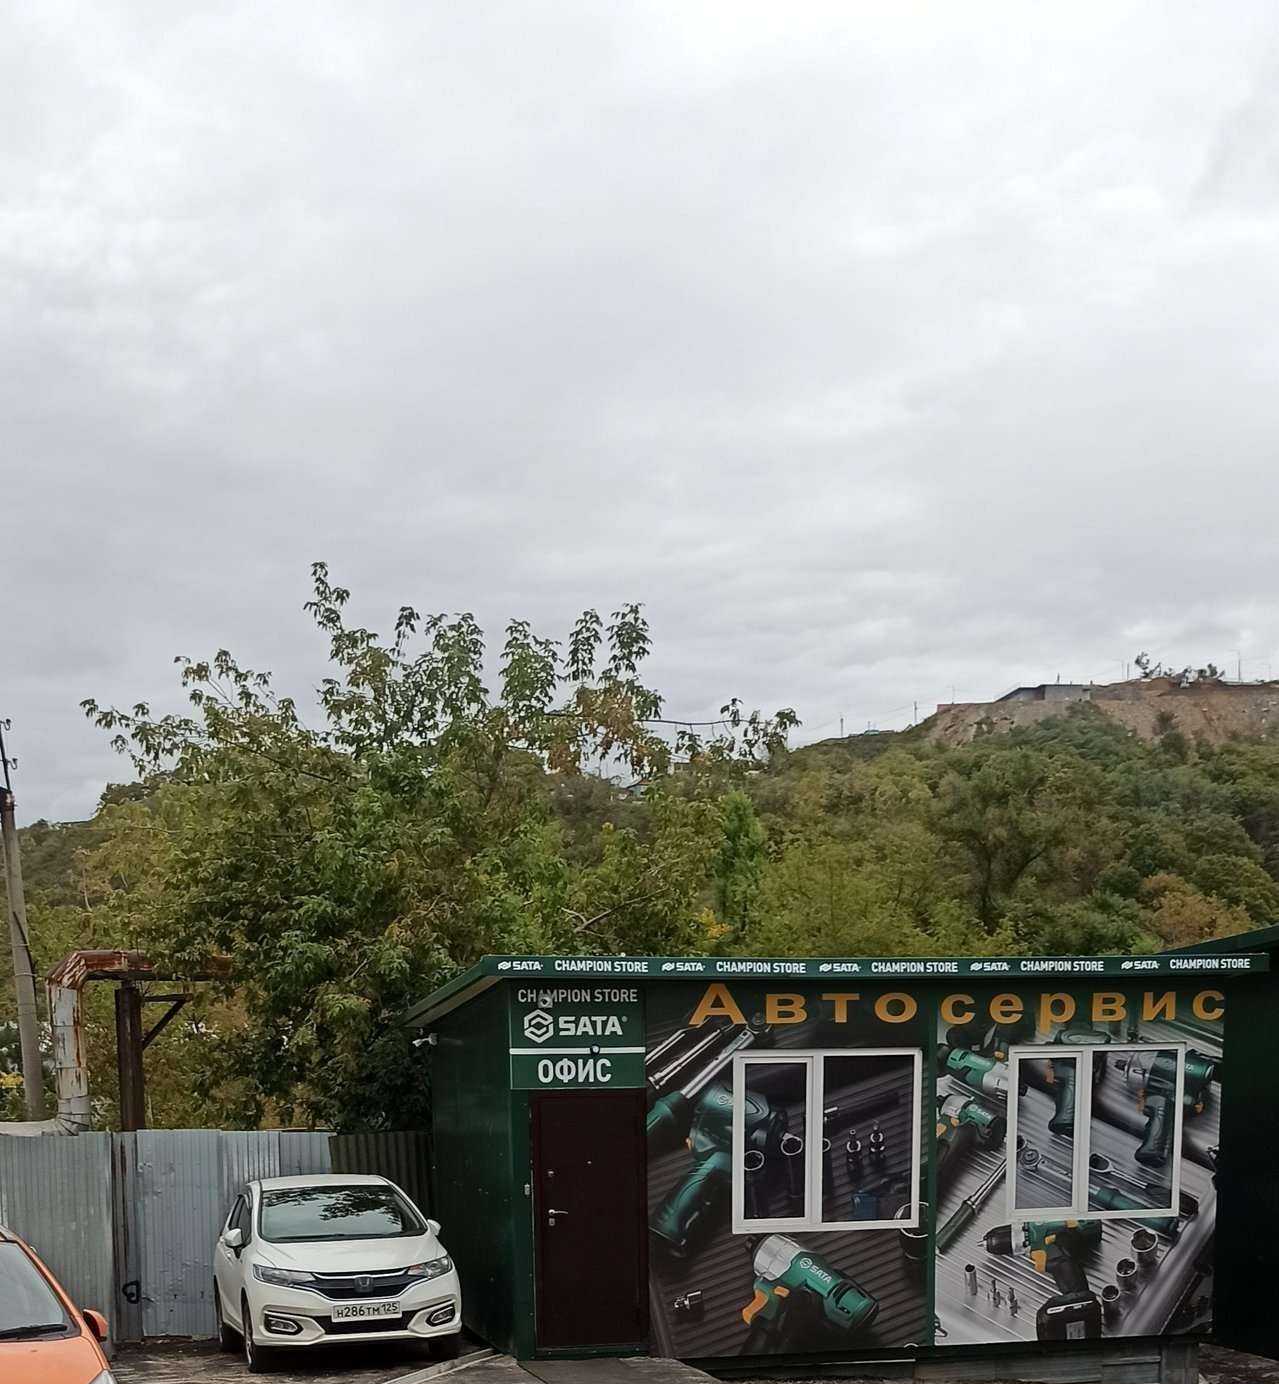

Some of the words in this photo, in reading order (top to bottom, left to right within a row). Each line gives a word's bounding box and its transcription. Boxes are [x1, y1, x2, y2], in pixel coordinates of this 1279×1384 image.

[512, 961, 543, 970] SATA
[554, 960, 612, 972] CHAMPION
[613, 961, 649, 973] STORE
[675, 962, 705, 972] SATA
[716, 961, 771, 973] CHAMPION
[773, 962, 807, 974] STORE
[832, 963, 861, 972] SATA
[871, 962, 924, 973] CHAMPION
[925, 962, 958, 973] STORE
[983, 962, 1010, 971] SATA
[1020, 961, 1072, 972] CHAMPION
[1073, 961, 1105, 972] STORE
[1133, 960, 1159, 970] SATA
[1169, 958, 1219, 969] CHAMPION
[1220, 958, 1250, 969] STORE
[594, 989, 638, 1002] STORE
[558, 1016, 624, 1036] SATA
[537, 1058, 612, 1084] ОФИС
[810, 1264, 832, 1284] SATA
